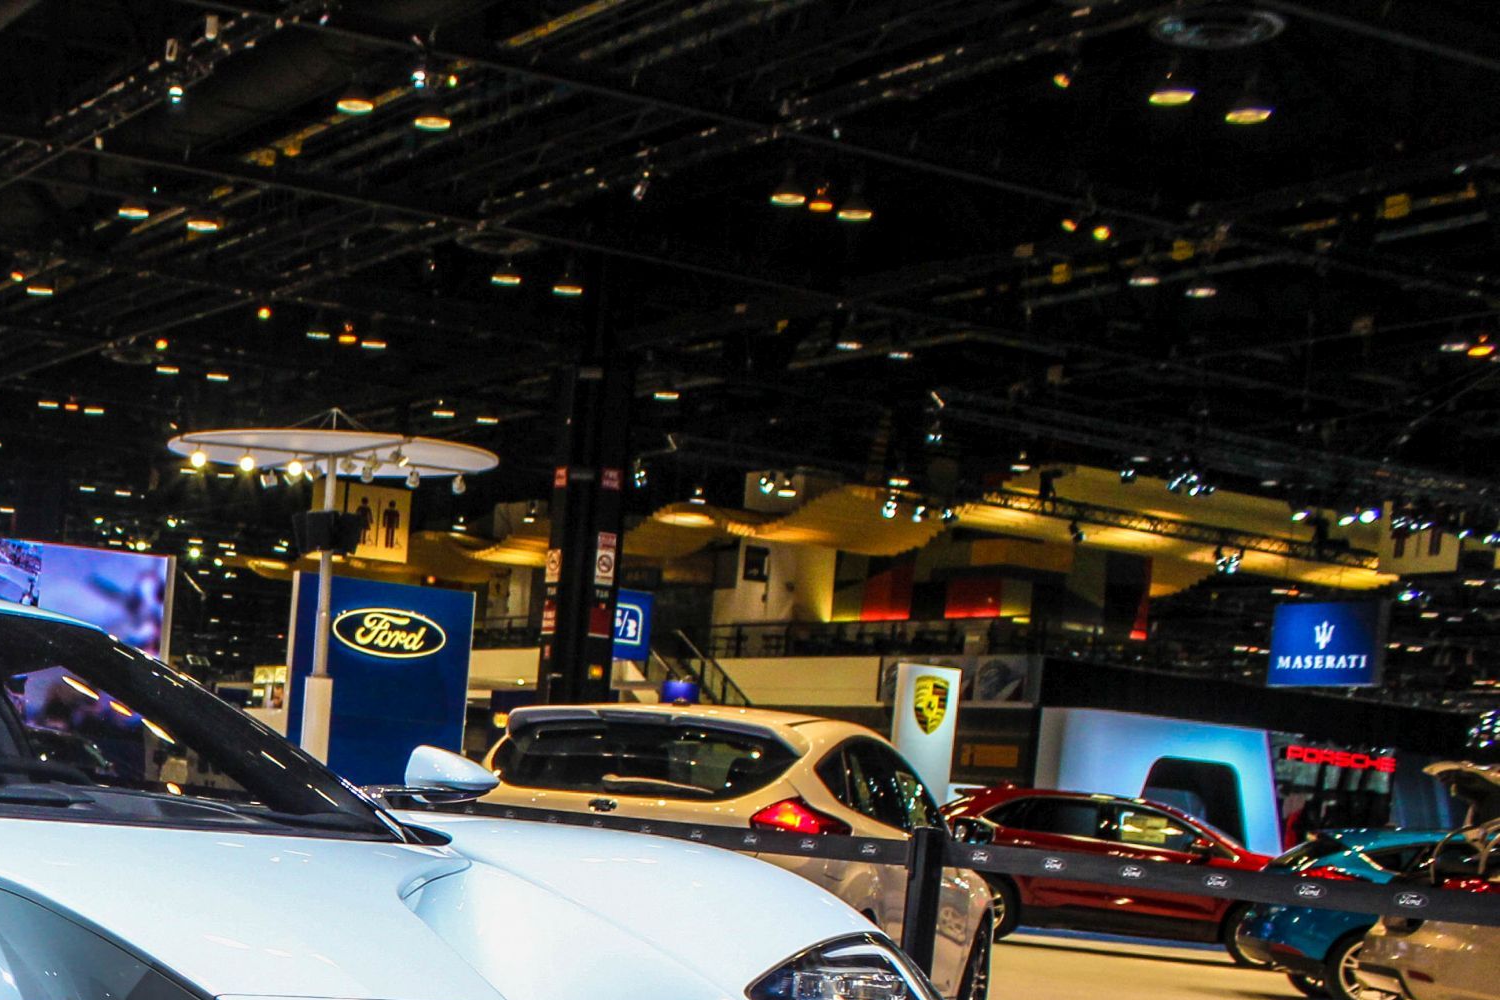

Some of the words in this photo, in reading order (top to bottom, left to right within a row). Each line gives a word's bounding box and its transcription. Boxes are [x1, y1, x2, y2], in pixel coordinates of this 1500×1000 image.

[355, 612, 427, 651] Ford
[1276, 654, 1368, 670] MASERATI
[1286, 745, 1396, 773] PORSCHE
